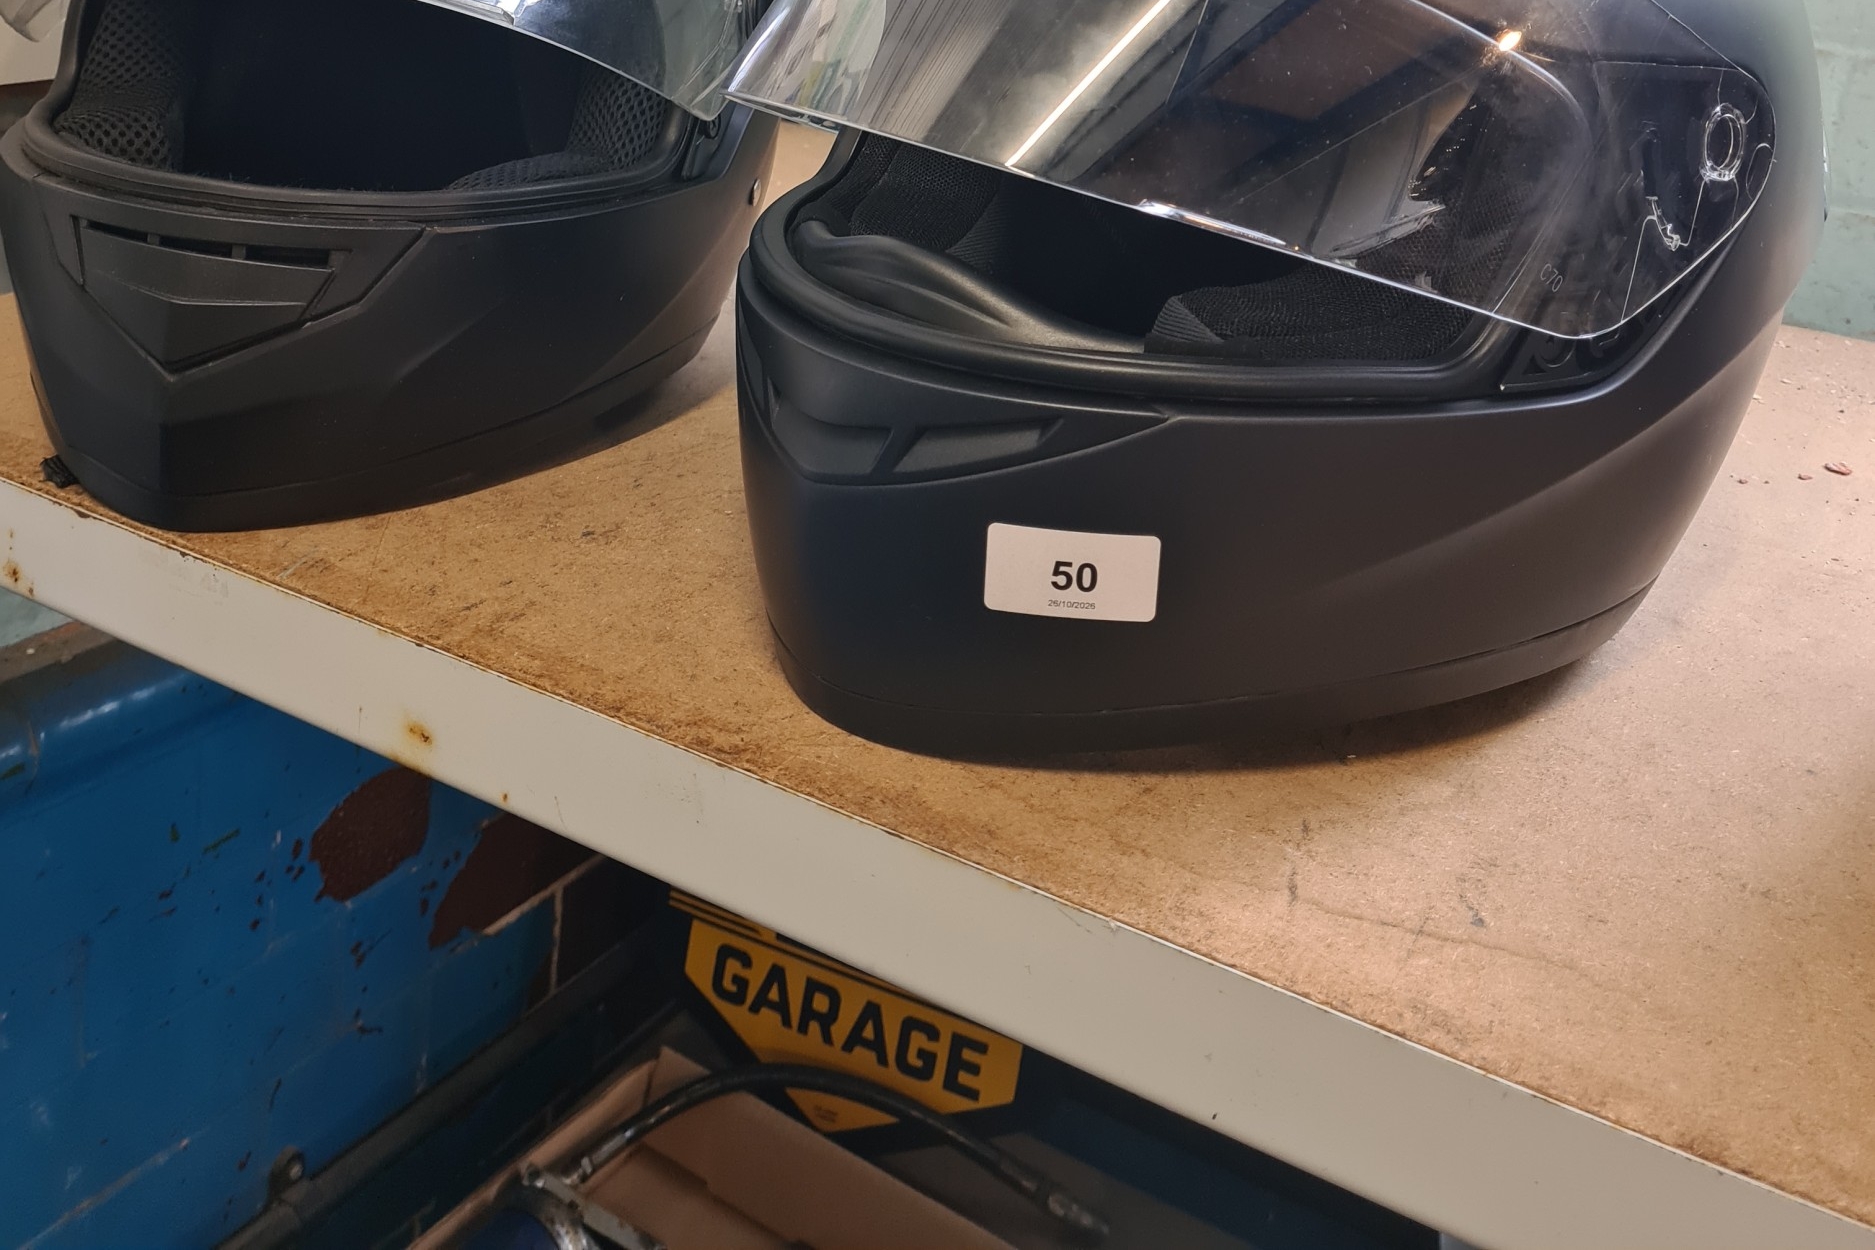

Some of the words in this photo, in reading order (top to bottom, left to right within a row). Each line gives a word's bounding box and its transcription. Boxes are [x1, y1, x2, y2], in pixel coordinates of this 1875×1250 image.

[1540, 263, 1563, 292] C70
[1050, 560, 1098, 592] 50
[711, 943, 989, 1104] GARAGE
